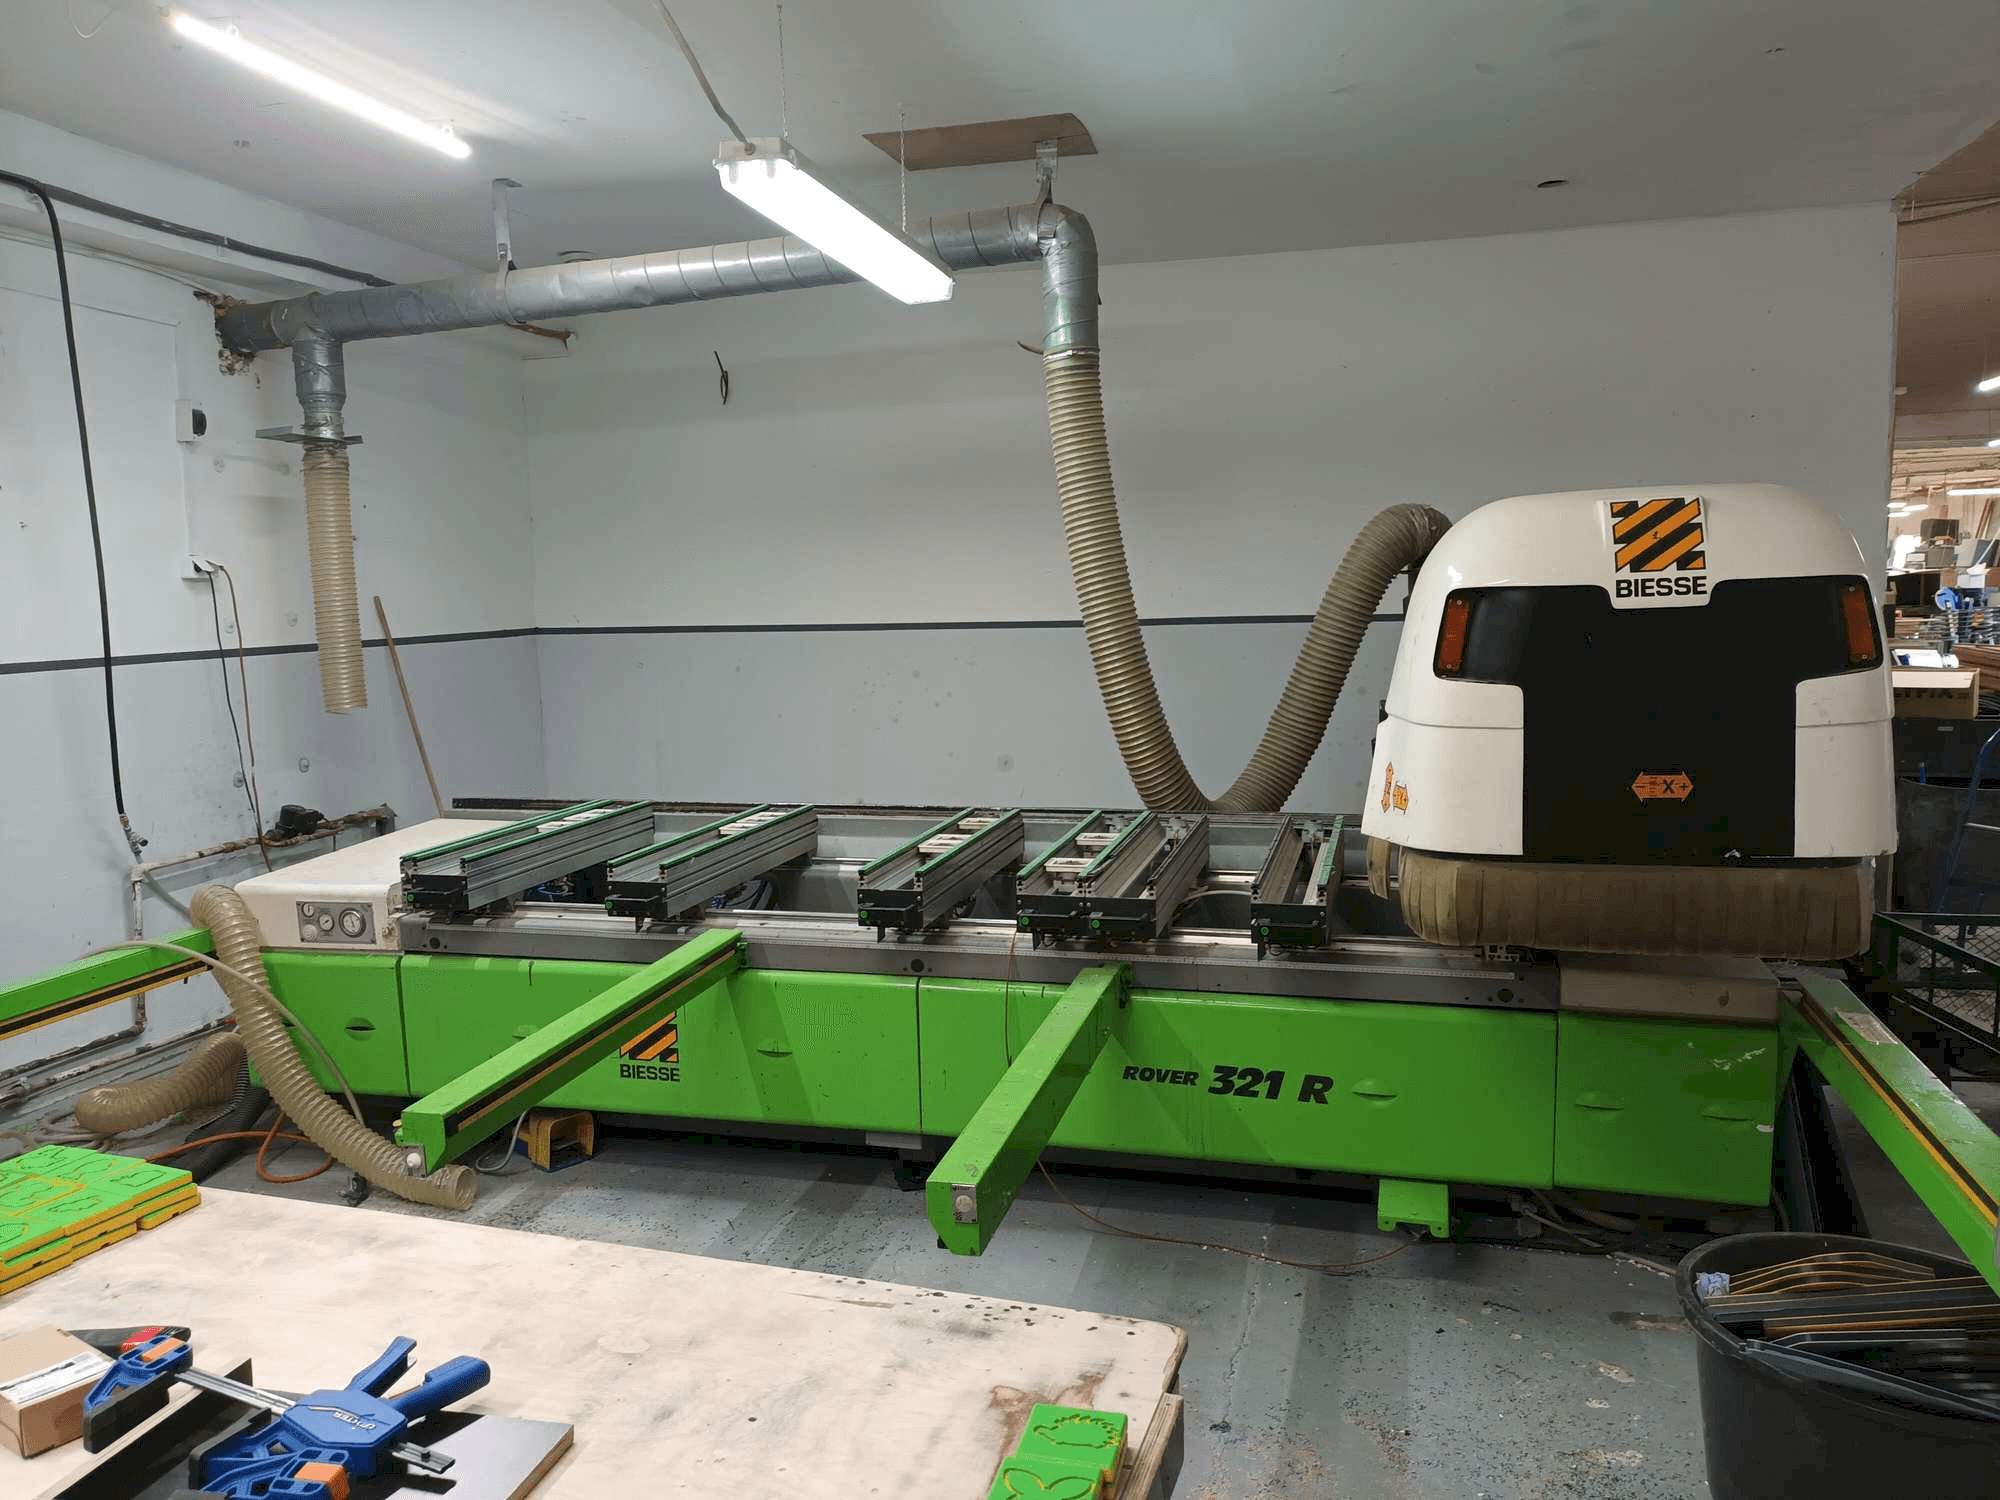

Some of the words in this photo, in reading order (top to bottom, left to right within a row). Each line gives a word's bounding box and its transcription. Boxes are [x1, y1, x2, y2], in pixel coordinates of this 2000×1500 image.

[1616, 576, 1707, 598] BIESSE
[620, 1063, 680, 1082] BIESSE
[1122, 1065, 1200, 1086] ROVER
[1207, 1065, 1286, 1100] 321
[1297, 1073, 1335, 1105] R
